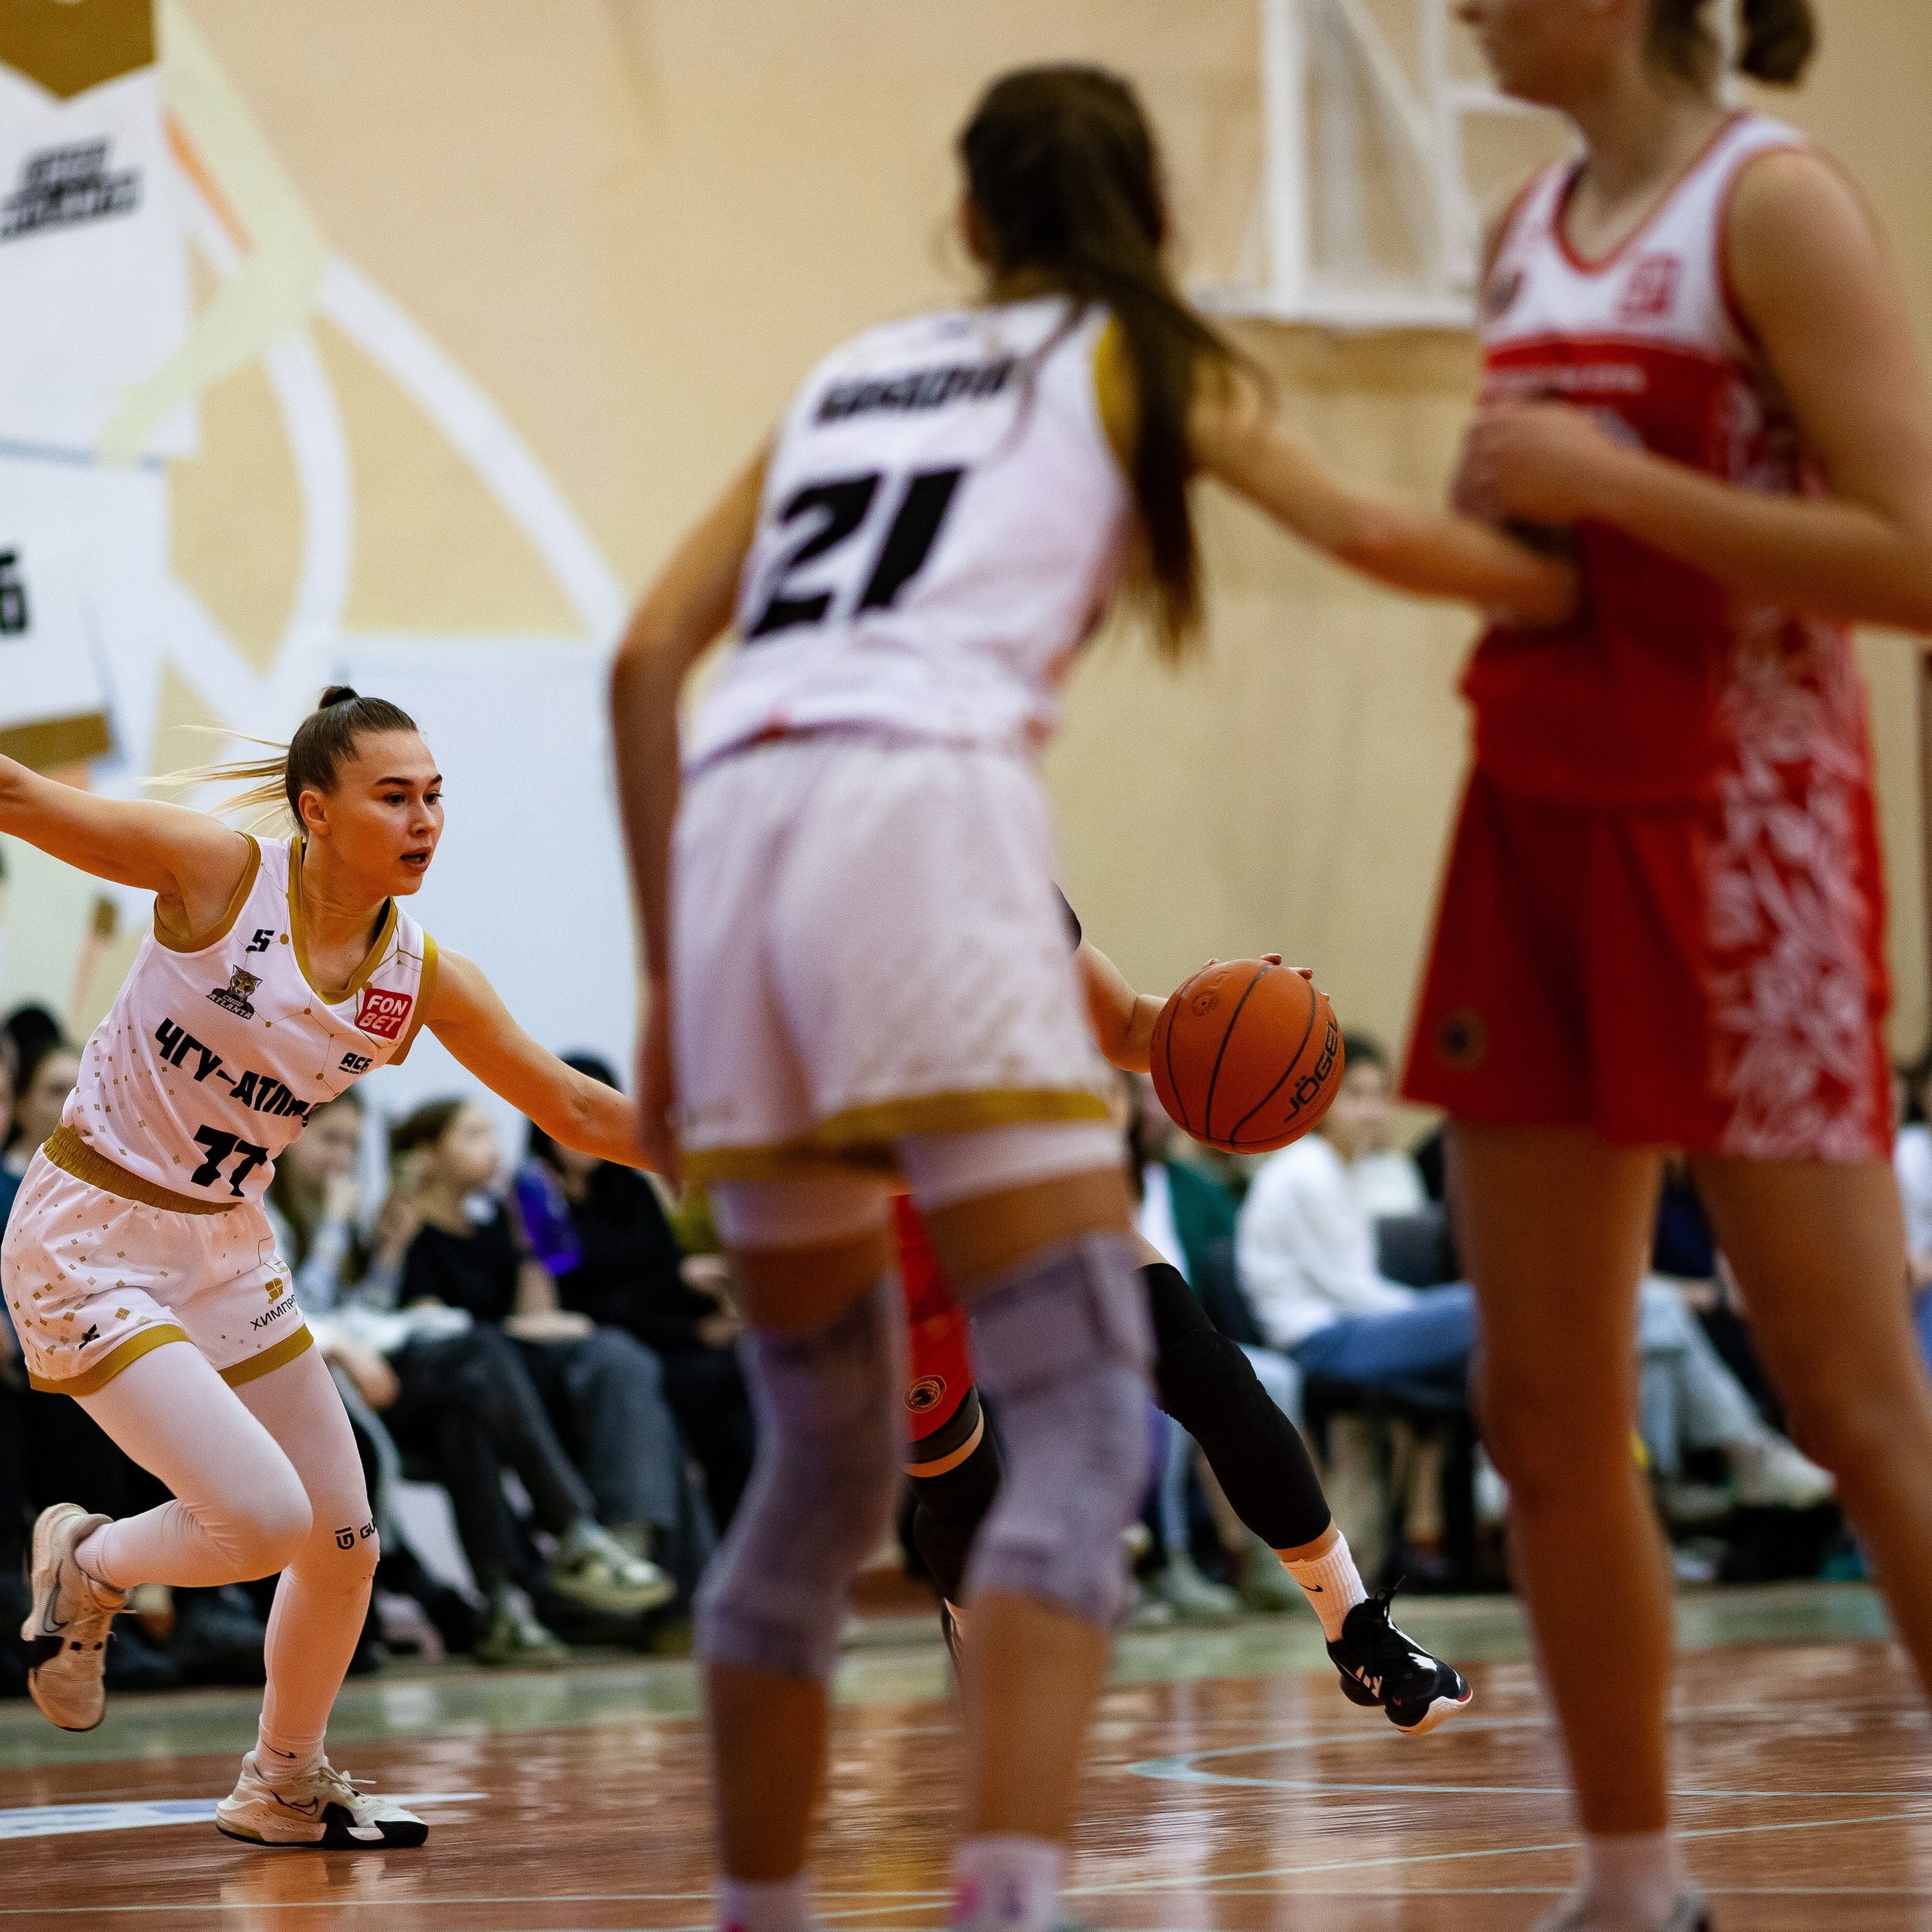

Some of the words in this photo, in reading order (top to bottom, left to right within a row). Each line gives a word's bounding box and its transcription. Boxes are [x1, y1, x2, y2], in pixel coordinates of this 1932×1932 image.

[744, 465, 965, 641] 21
[207, 993, 253, 1019] ATLANTA
[223, 995, 245, 1008] CHGU
[366, 995, 408, 1016] FON
[358, 1012, 401, 1032] BET
[1283, 1016, 1339, 1124] JÖGEL
[190, 1124, 270, 1198] 77
